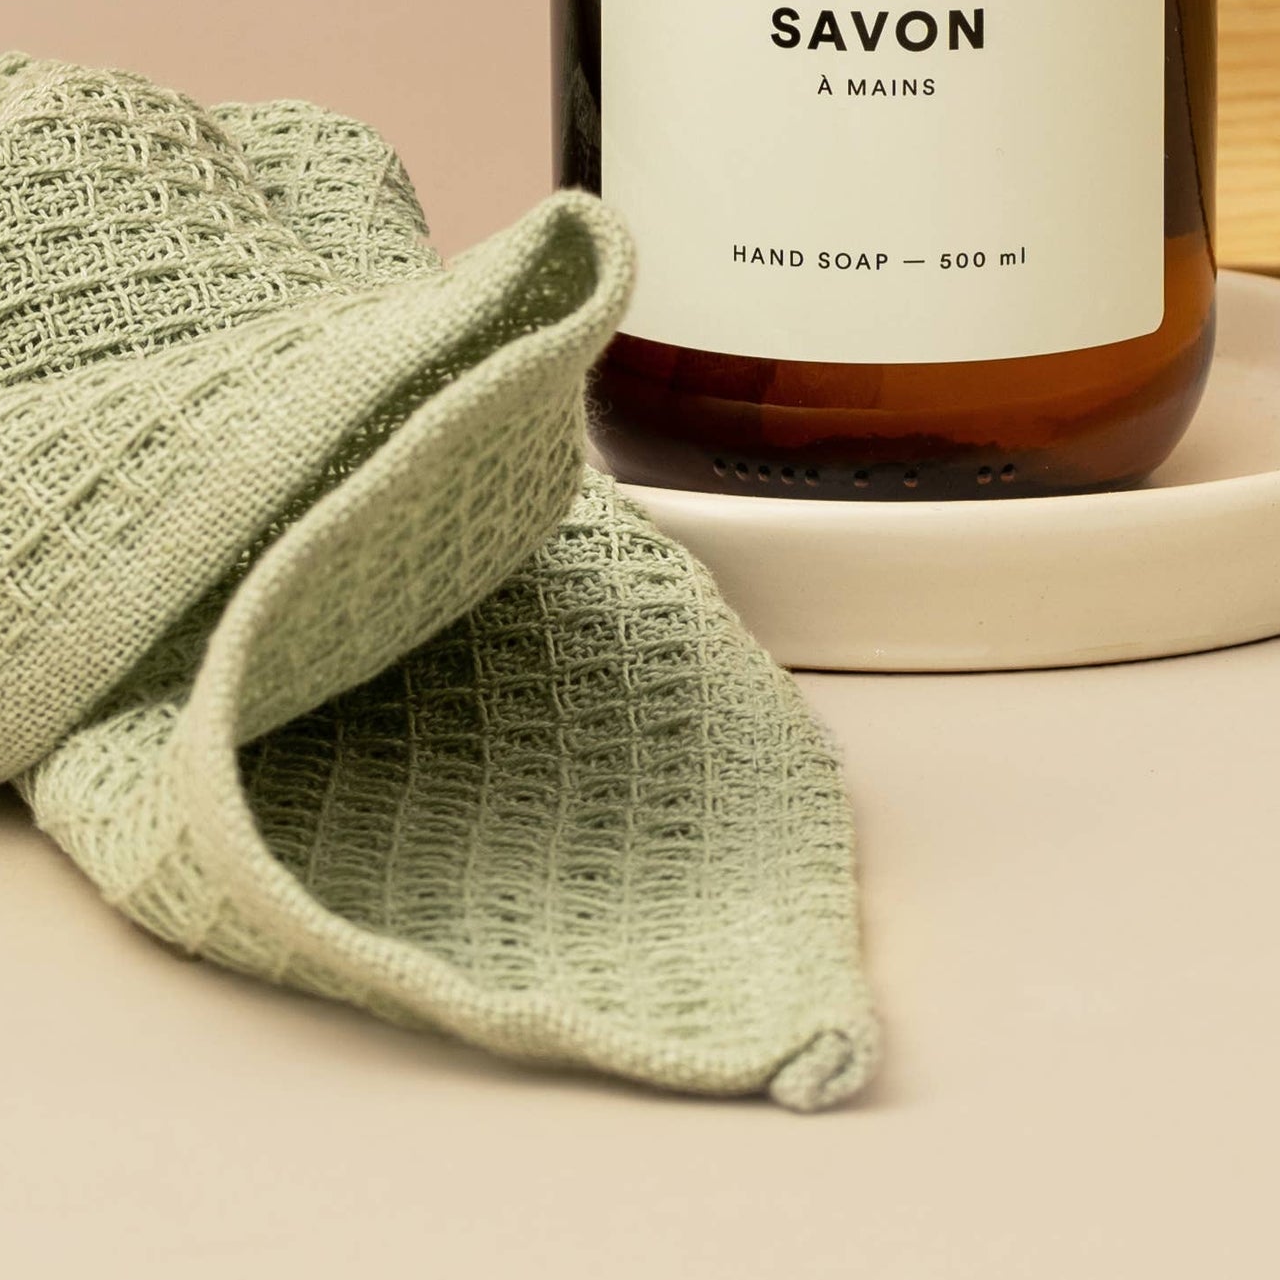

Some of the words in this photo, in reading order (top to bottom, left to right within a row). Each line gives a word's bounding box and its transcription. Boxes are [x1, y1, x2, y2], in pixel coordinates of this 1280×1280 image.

[770, 6, 986, 52] SAVON
[817, 74, 833, 96] À
[847, 78, 936, 97] MAINS
[733, 244, 805, 268] HAND
[817, 251, 889, 271] SOAP
[939, 251, 987, 270] 500
[999, 246, 1026, 267] ml
